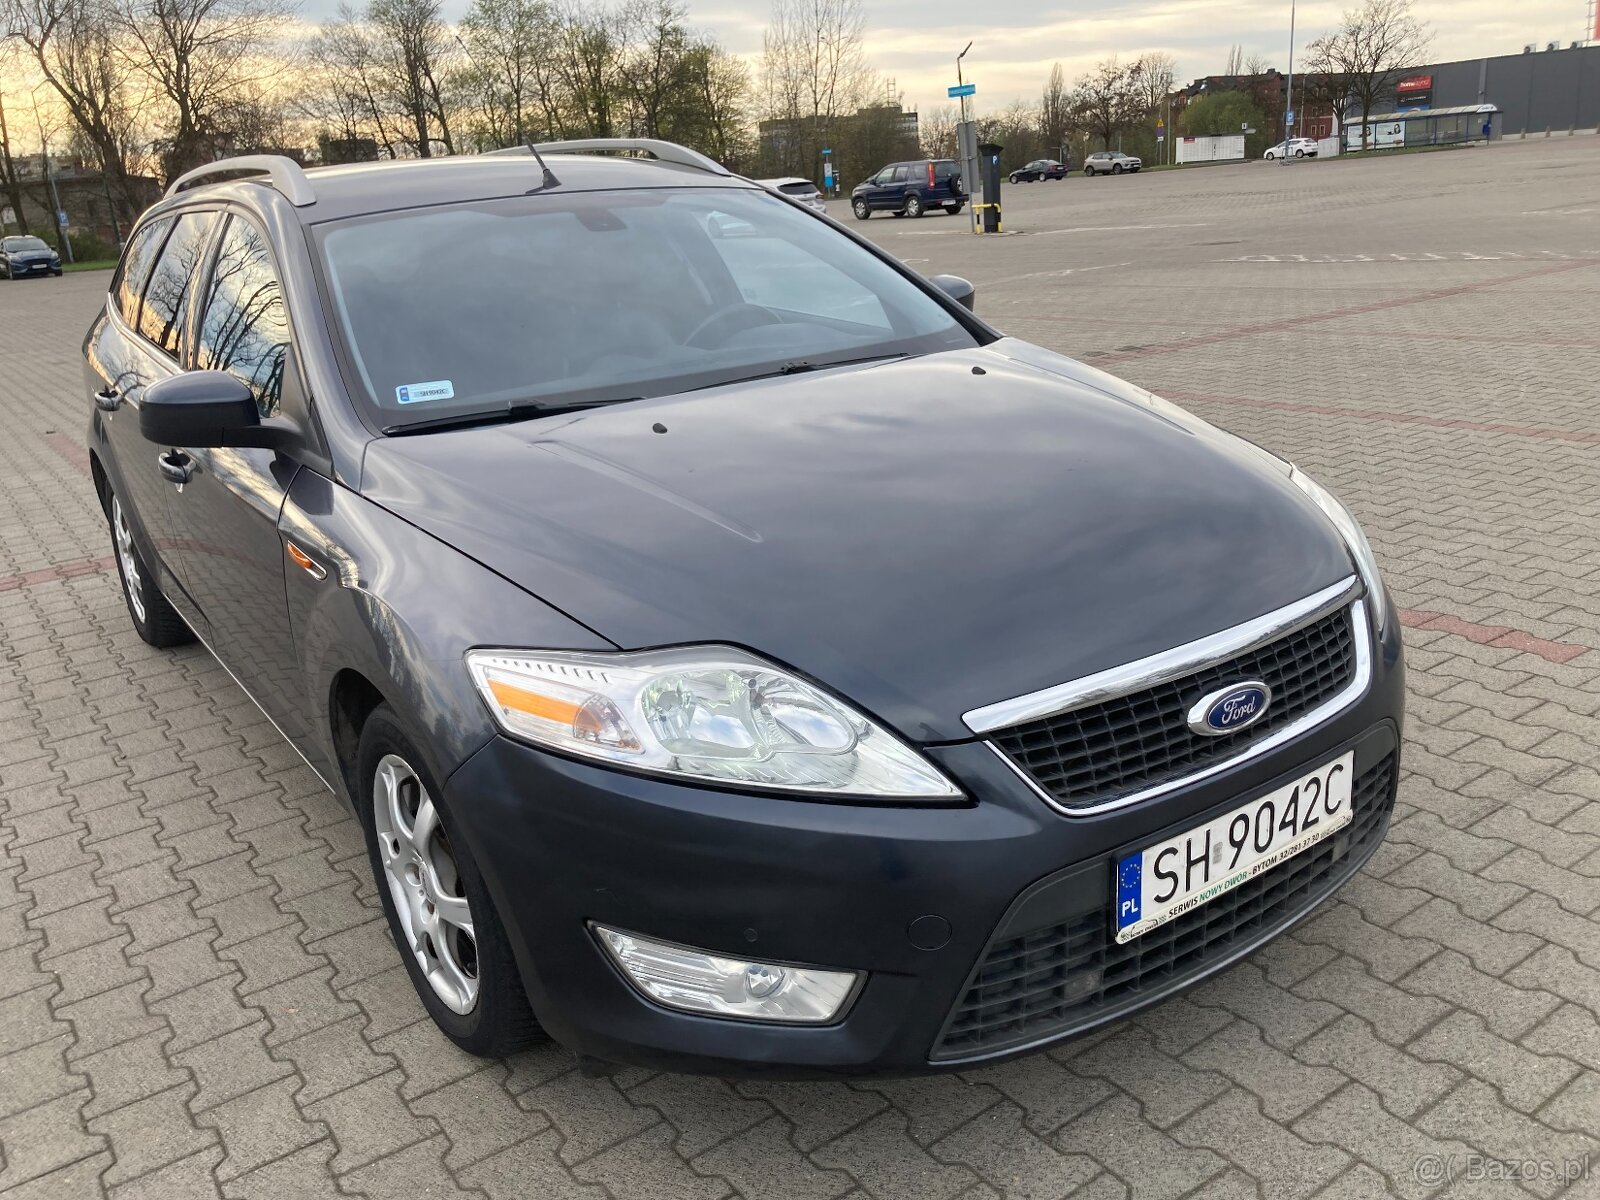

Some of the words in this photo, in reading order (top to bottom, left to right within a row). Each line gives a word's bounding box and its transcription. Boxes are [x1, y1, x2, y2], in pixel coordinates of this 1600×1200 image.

[1221, 694, 1256, 725] Ford
[1153, 829, 1211, 904] SH
[1228, 763, 1344, 871] 9042C
[1122, 898, 1139, 918] PL
[1168, 896, 1199, 918] SERWIS
[1199, 882, 1224, 902] NOWY
[1252, 855, 1278, 875] BYTOM
